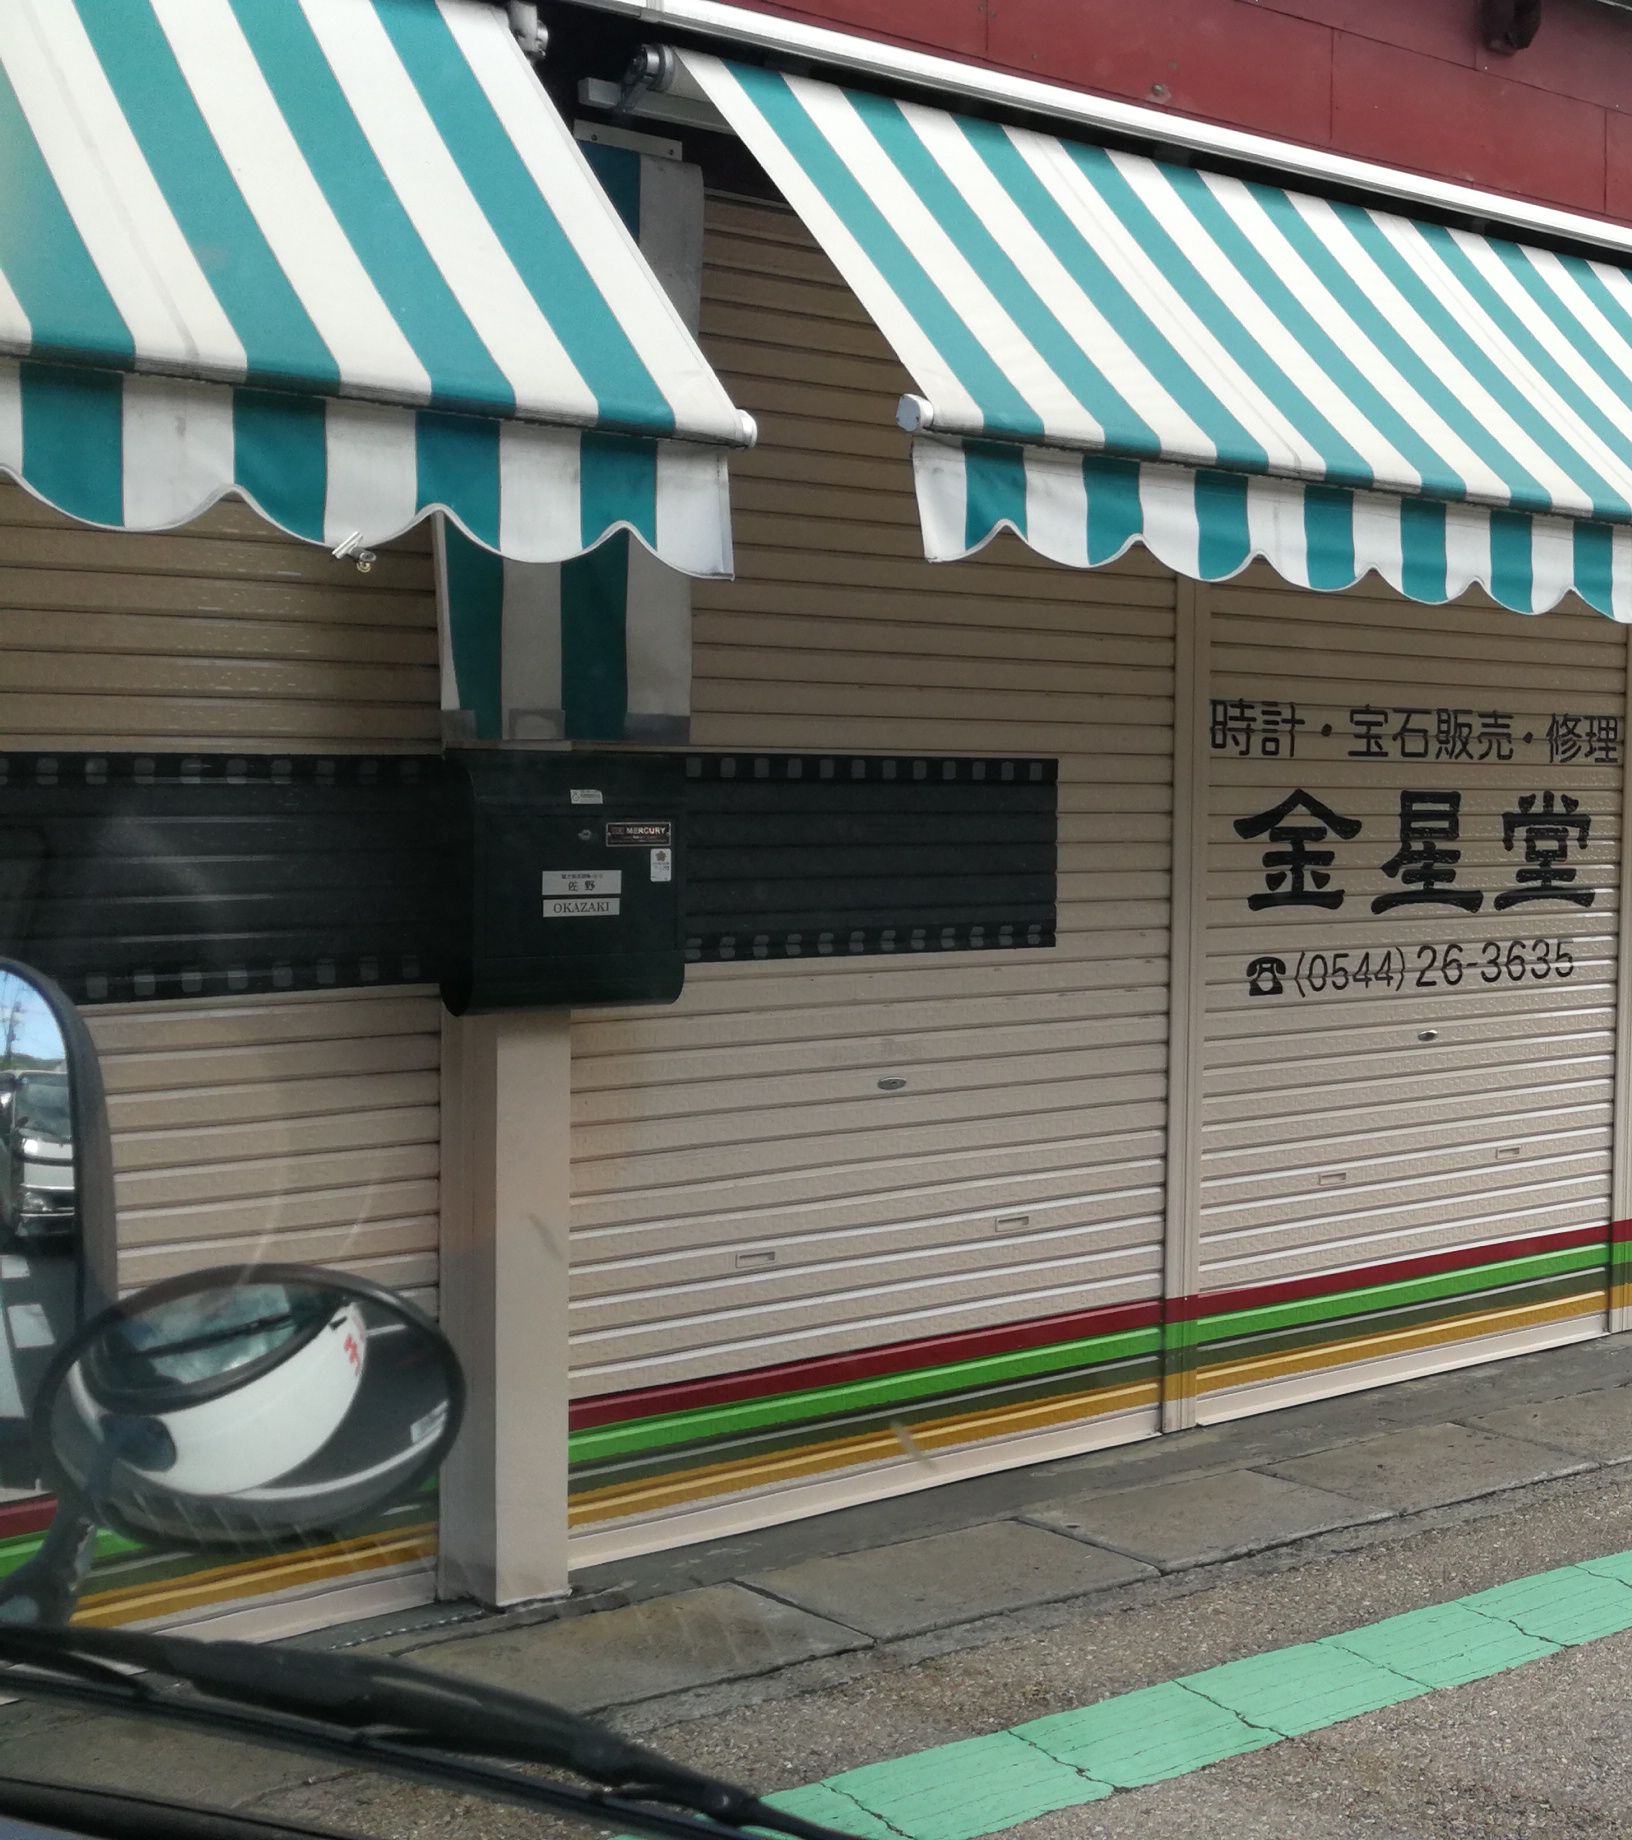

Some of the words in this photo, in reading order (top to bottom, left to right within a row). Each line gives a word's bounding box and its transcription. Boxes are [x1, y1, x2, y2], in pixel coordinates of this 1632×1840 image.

[625, 826, 666, 835] MERCURY
[1233, 787, 1596, 914] 金星堂
[553, 901, 610, 914] OKAZAKI
